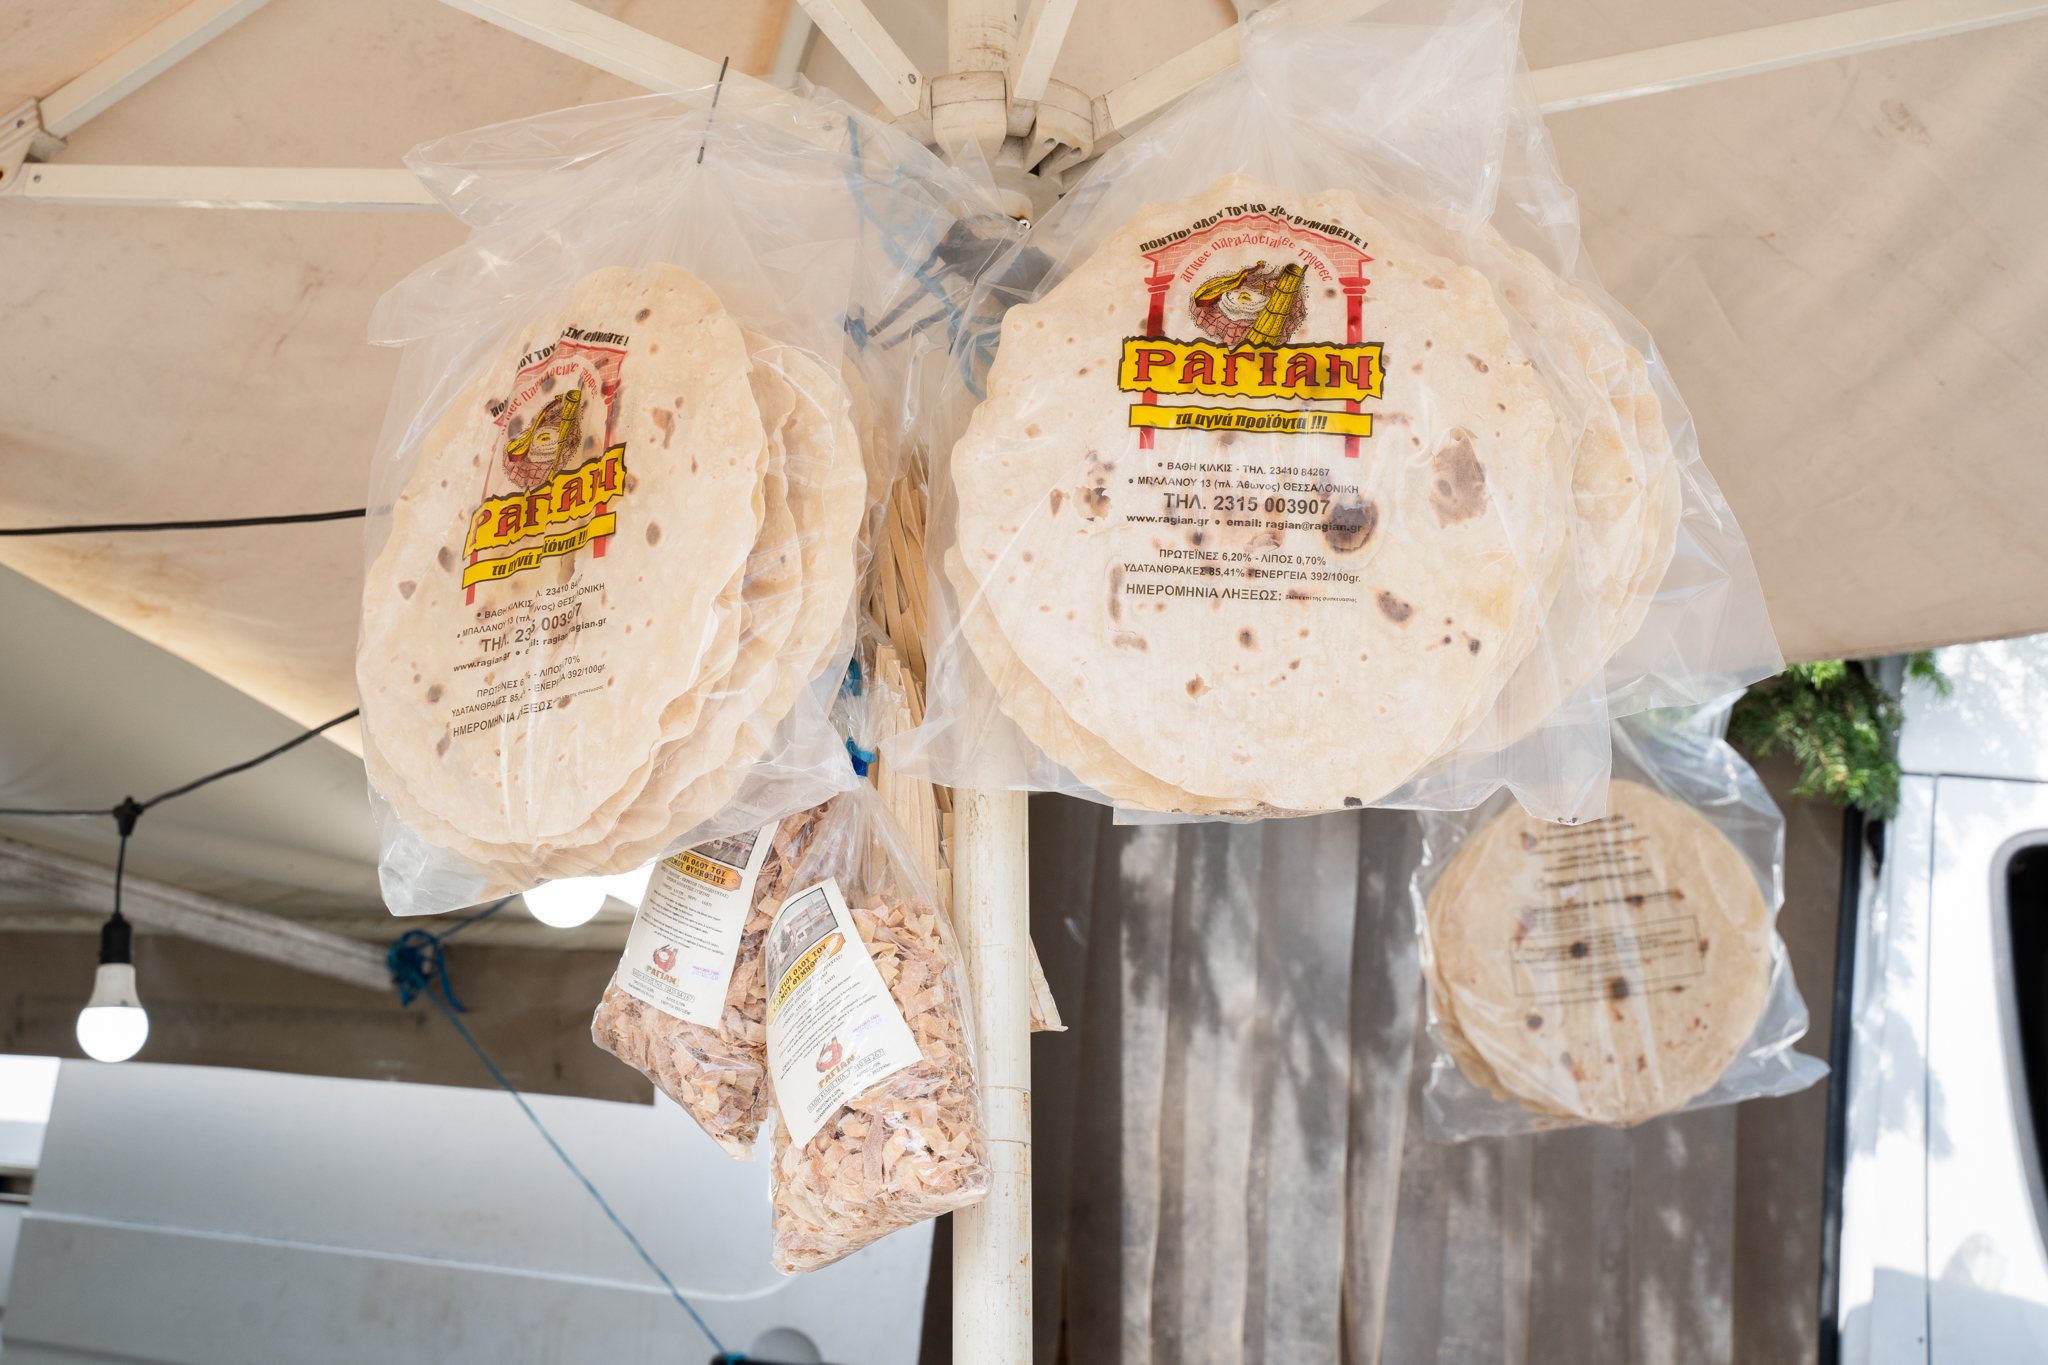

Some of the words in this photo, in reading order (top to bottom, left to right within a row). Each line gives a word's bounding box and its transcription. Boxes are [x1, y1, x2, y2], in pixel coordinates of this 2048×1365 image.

[1139, 228, 1191, 252] ΠΟΝΤΙΟΙ
[1192, 210, 1223, 229] ΟΛΟΥ
[1225, 203, 1248, 216] ΤΟΥ
[1176, 412, 1191, 425] τα
[1195, 413, 1232, 430] αγνά
[1235, 413, 1309, 431] προϊόντα
[1167, 462, 1197, 471] ΒΑΘΗ
[1199, 463, 1233, 472] ΚΙΛΚΙΣ
[1243, 465, 1266, 475] ΤΗΛ.
[1269, 466, 1299, 476] 23410
[1301, 467, 1331, 477] 84267
[1137, 477, 1197, 487] ΜΠΑΛΑΝΟΥ
[1200, 479, 1211, 488] 13
[1214, 480, 1234, 490] (πλ.
[1283, 482, 1359, 494] ΘΕΣΣΑΛΟΝΙΚΗ
[1163, 493, 1207, 510] ΤΗΛ.
[1213, 495, 1258, 512] 2315
[1264, 497, 1331, 515] 003907
[1126, 515, 1209, 527] www.ragian.gr
[1226, 519, 1262, 527] email:
[1266, 520, 1363, 533] ragian@ragian.gr
[1159, 548, 1219, 561] ΠΡΩΤΕΪΝΕΣ
[1221, 552, 1252, 562] 6,20%
[1260, 554, 1294, 564] ΛΙΠΟΣ
[1296, 555, 1327, 566] 0,70%
[492, 563, 507, 576] τα
[1123, 563, 1206, 576] ΥΔΑΤΑΝΘΡΑΚΕΣ
[1208, 567, 1245, 578] 85,41%
[1254, 569, 1308, 580] ΕΝΕΡΓΕΙΑ
[1310, 571, 1361, 585] 392/100gr.
[545, 586, 569, 596] 23410
[1126, 583, 1219, 599] ΗΜΕΡΟΜΗΝΙΑ
[1221, 587, 1282, 602] ΛΗΞΕΩΣ:
[711, 866, 727, 877] ΤΟΥ
[793, 957, 810, 975] ΟΛΟΥ
[812, 943, 827, 957] ΤΟΥ
